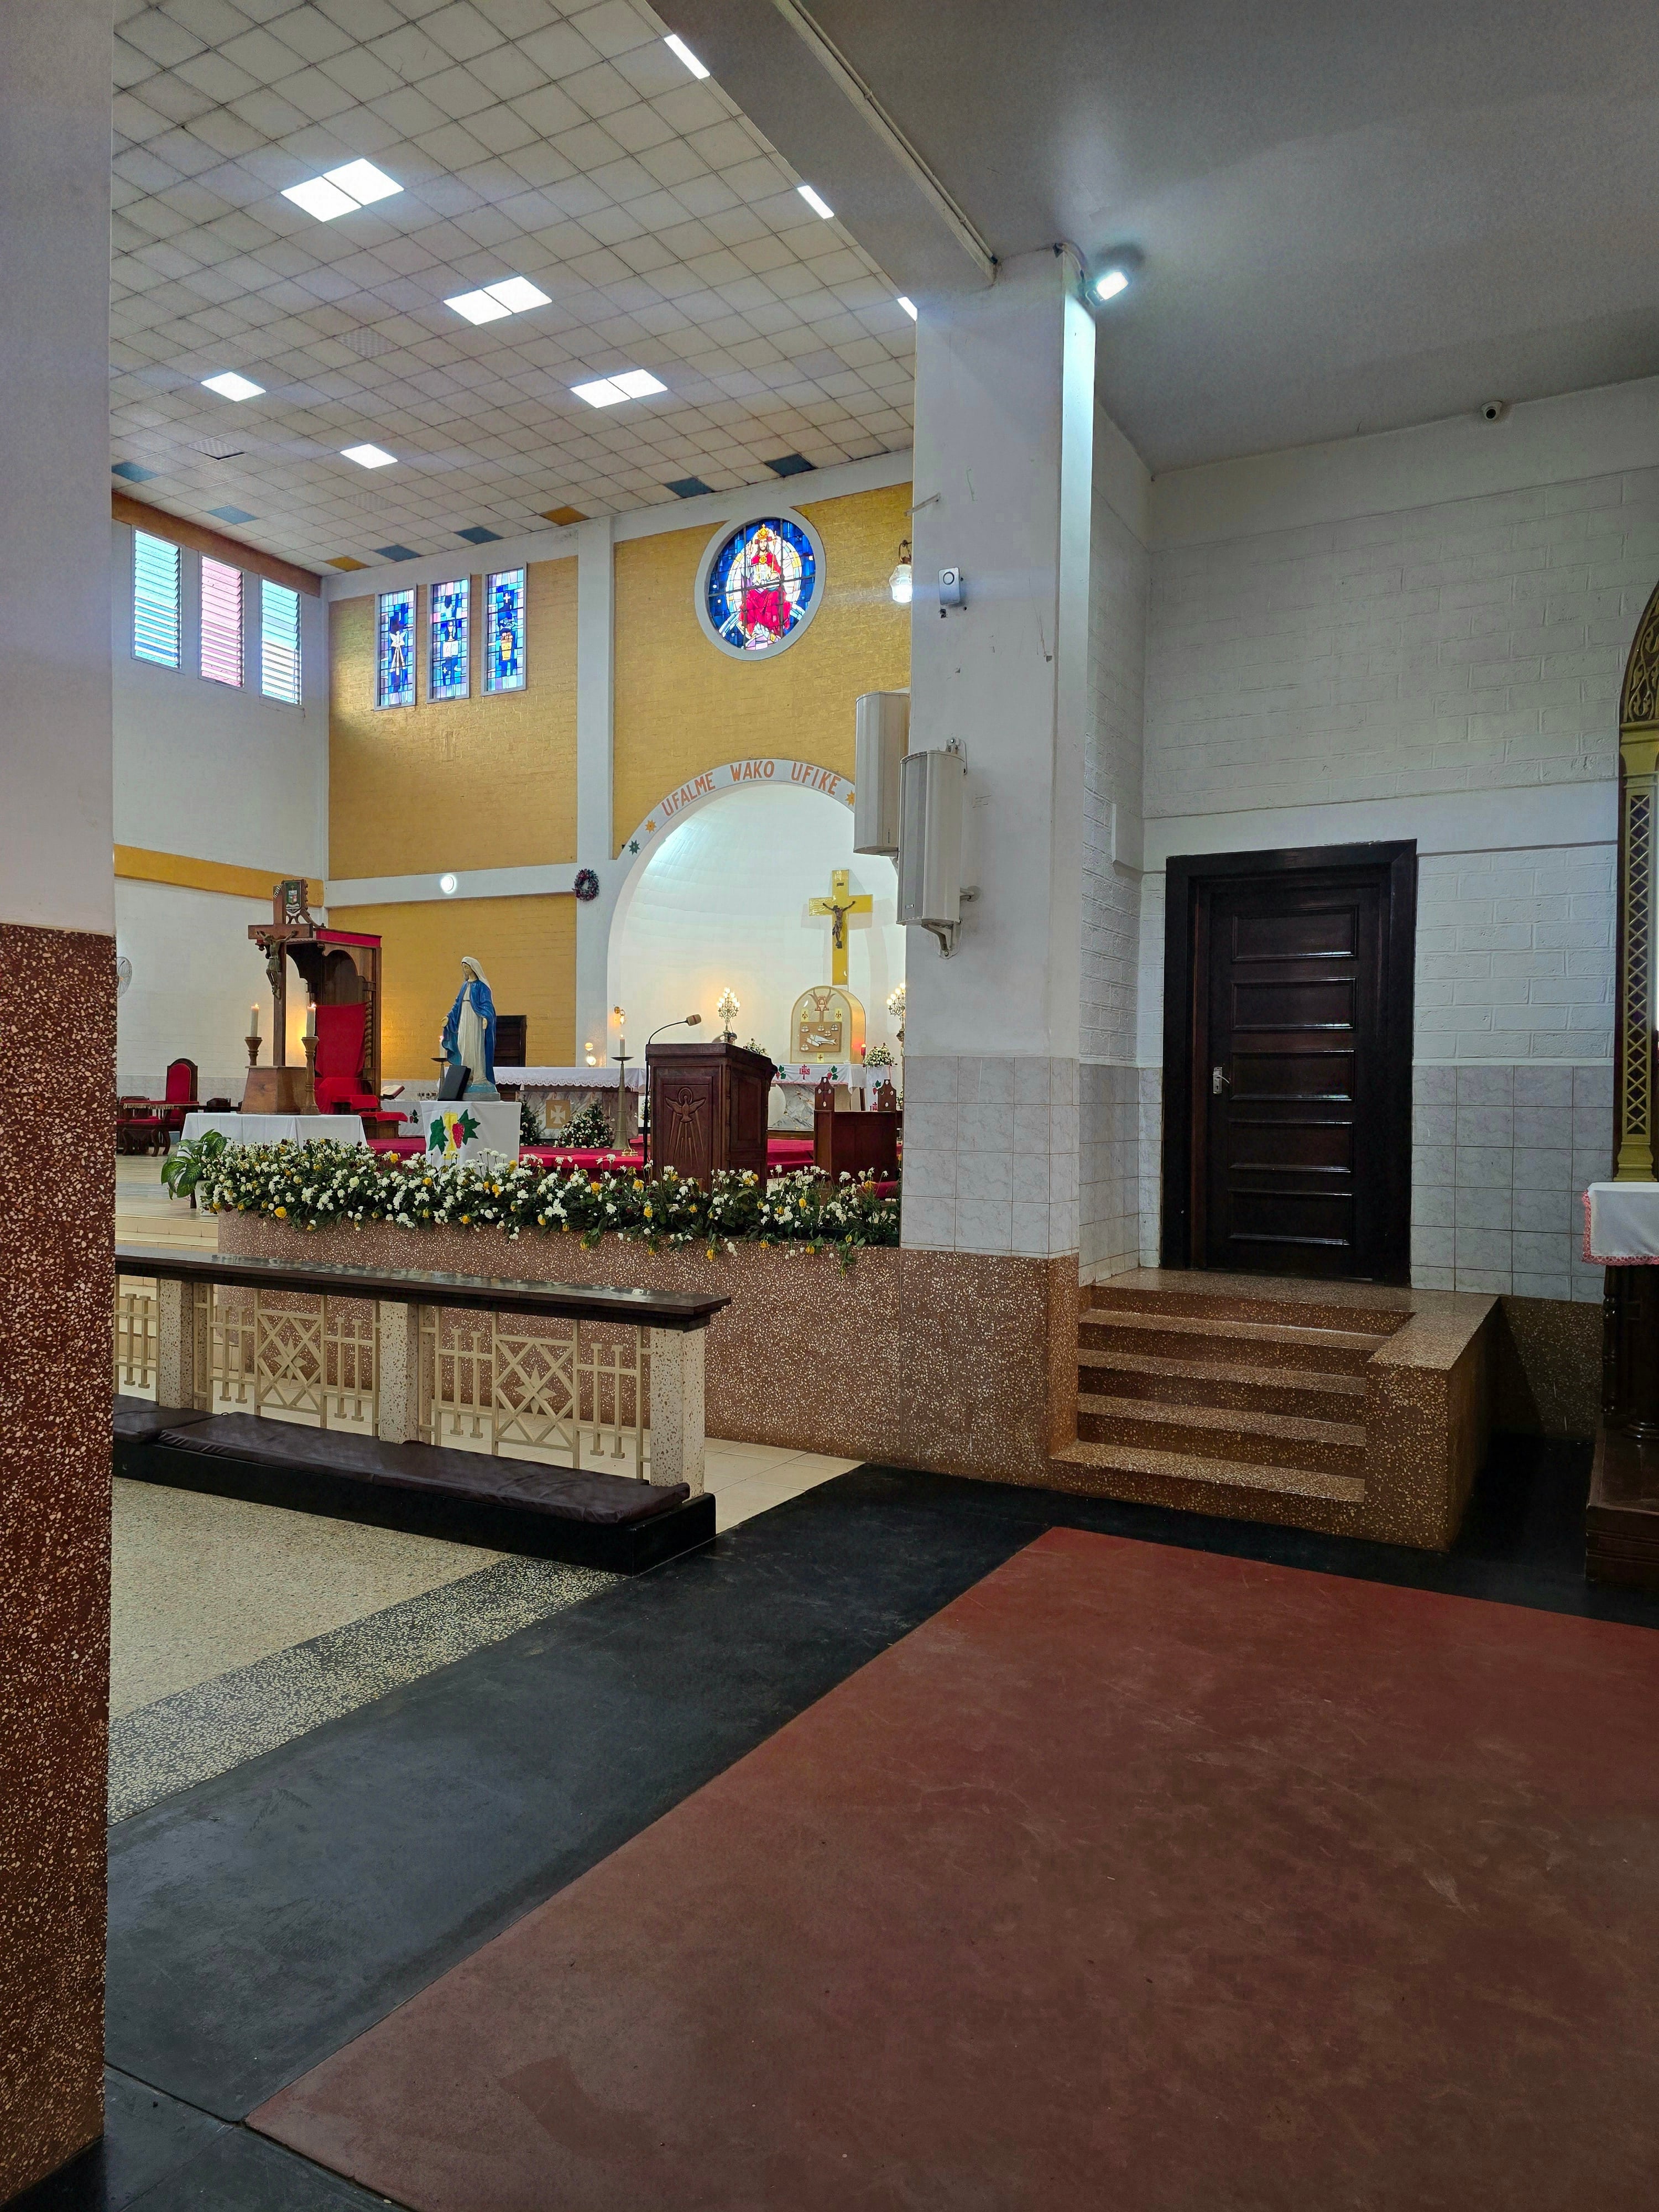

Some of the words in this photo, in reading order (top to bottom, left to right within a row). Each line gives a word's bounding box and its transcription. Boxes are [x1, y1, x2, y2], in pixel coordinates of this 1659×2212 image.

[661, 772, 716, 816] UFALME
[730, 760, 774, 782] WAKO
[791, 762, 841, 795] UFIKE
